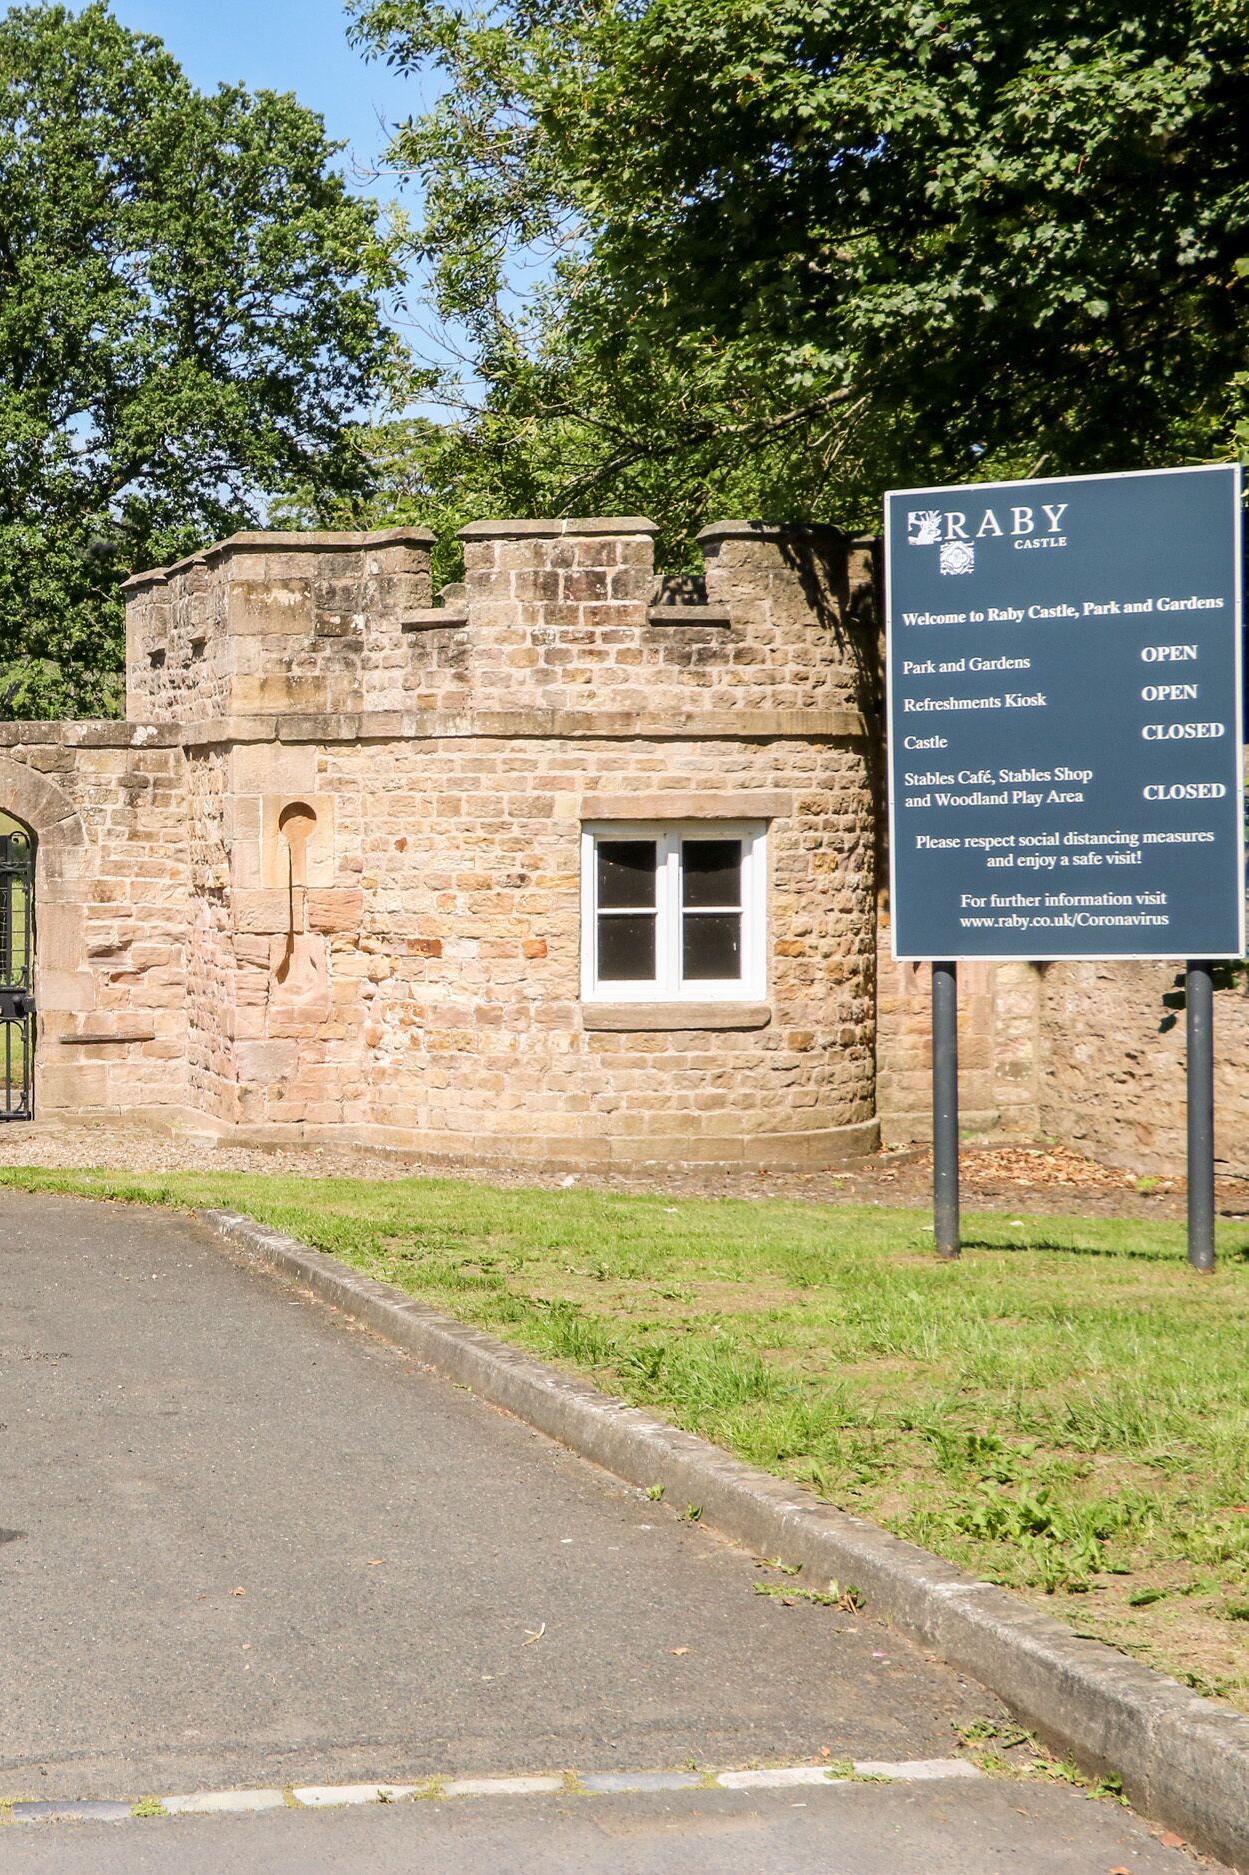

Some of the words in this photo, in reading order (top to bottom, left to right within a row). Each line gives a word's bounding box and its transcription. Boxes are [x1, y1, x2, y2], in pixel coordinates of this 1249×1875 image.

[943, 503, 1069, 540] RABY
[1013, 536, 1068, 550] CASTLE
[902, 612, 966, 627] Welcome
[969, 611, 985, 623] to
[987, 607, 1026, 624] Raby
[1028, 603, 1080, 620] Castle,
[1082, 601, 1121, 616] Park
[1124, 599, 1154, 613] and
[1156, 596, 1225, 612] Gardens
[1140, 644, 1199, 663] OPEN
[902, 660, 937, 675] Park
[939, 658, 966, 672] and
[968, 656, 1031, 671] Gardens
[1140, 683, 1199, 702] OPEN
[903, 696, 1002, 713] Refreshments
[1004, 693, 1048, 708] Kiosk
[1141, 722, 1226, 741] CLOSED
[903, 735, 949, 750] Castle
[904, 771, 955, 787] Stables
[957, 769, 997, 786] Café,
[999, 768, 1052, 783] Stables
[1054, 766, 1094, 785] Shop
[904, 793, 932, 808] and
[934, 791, 1010, 807] Woodland
[1012, 790, 1044, 808] Play
[1045, 789, 1085, 804] Area
[1142, 782, 1227, 801] CLOSED
[915, 835, 961, 849] Please
[963, 834, 1016, 852] respect
[1018, 831, 1061, 847] social
[1063, 830, 1141, 848] distancing
[1142, 831, 1215, 844] measures
[986, 853, 1015, 868] and
[1017, 853, 1058, 871] enjoy
[1059, 855, 1071, 866] a
[1072, 851, 1104, 866] safe
[1104, 850, 1143, 865] visit!
[959, 894, 988, 908] For
[990, 893, 1043, 908] further
[1044, 892, 1133, 907] information
[1134, 890, 1168, 905] visit
[959, 911, 1170, 931] www.raby.co.uk/Coronavirus
